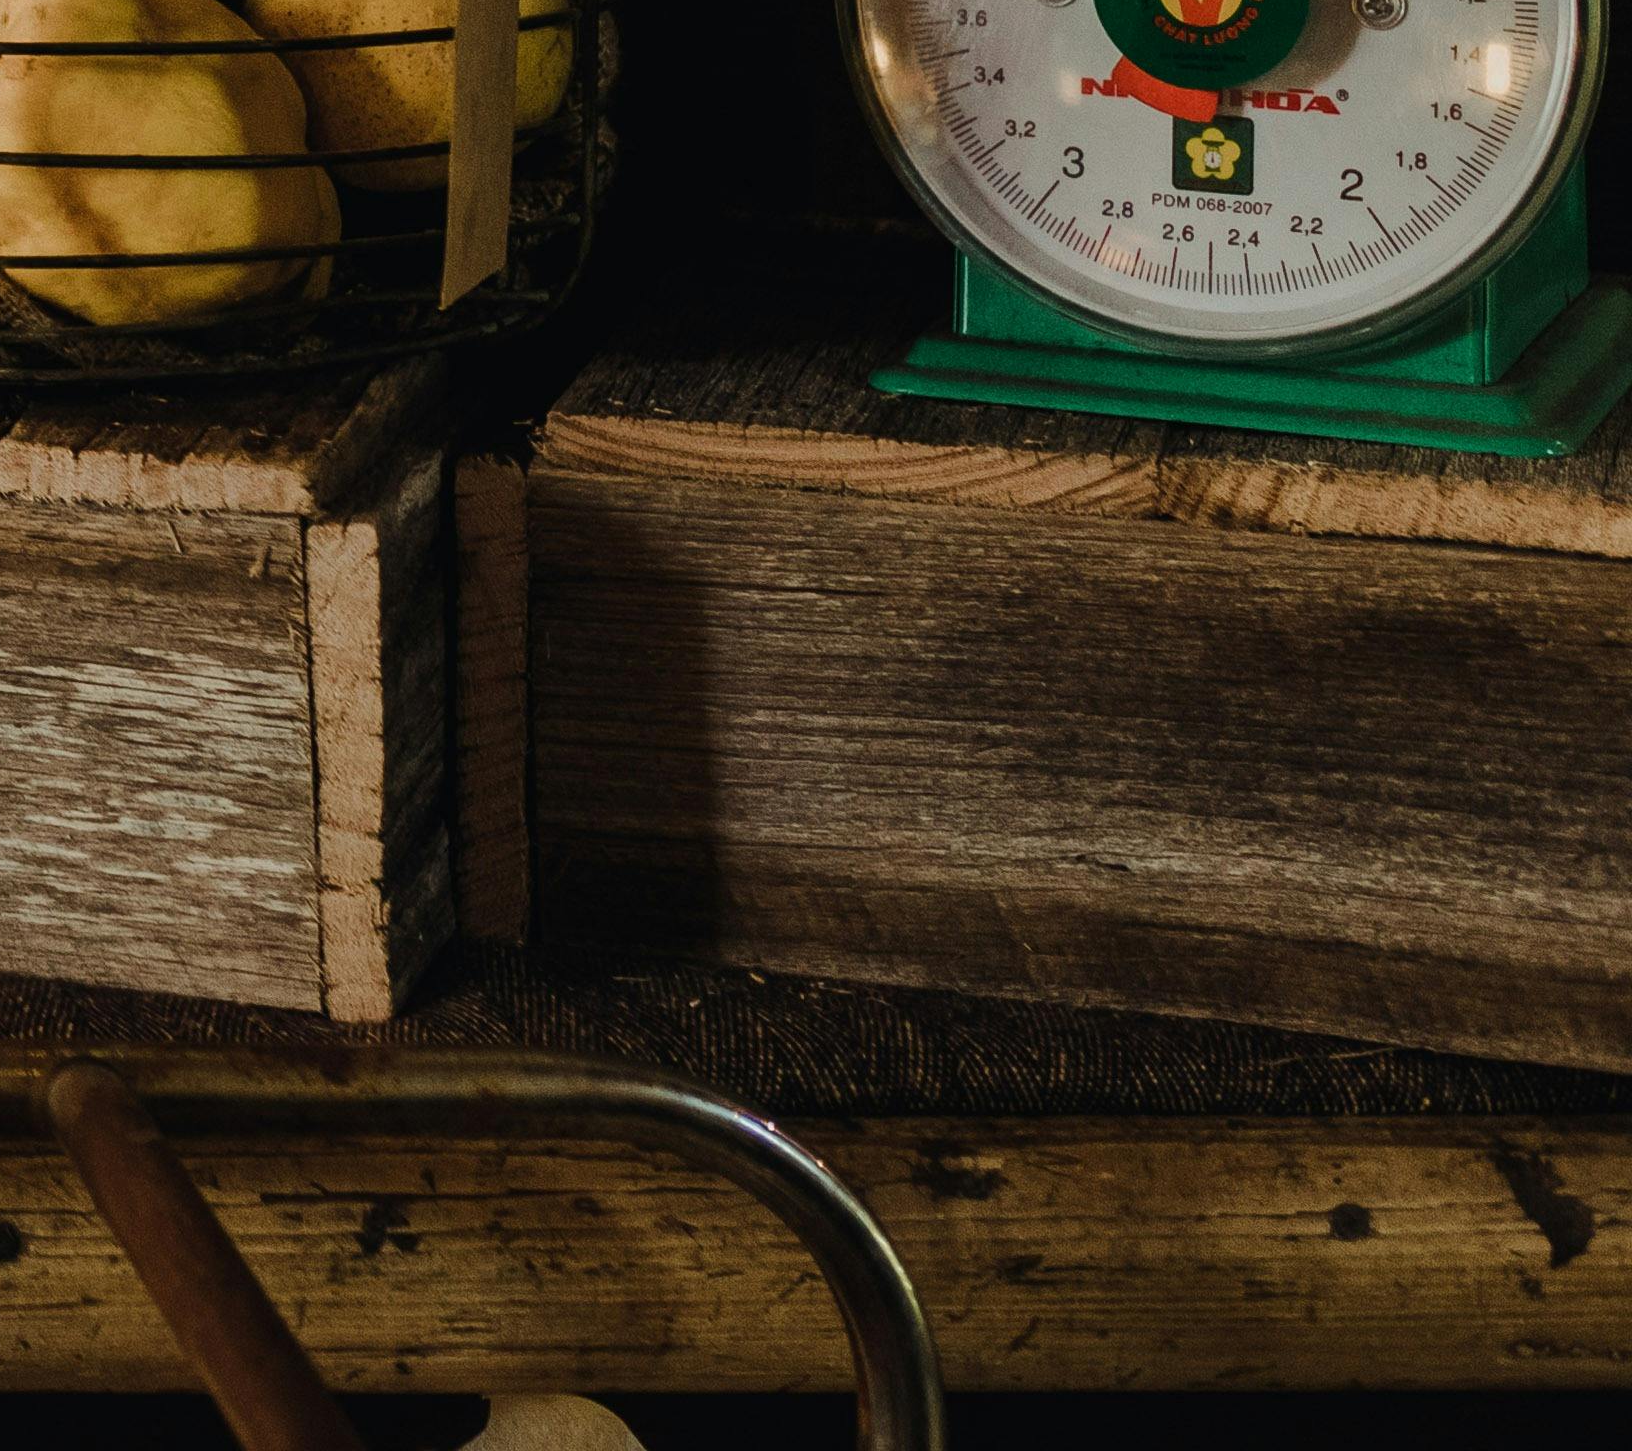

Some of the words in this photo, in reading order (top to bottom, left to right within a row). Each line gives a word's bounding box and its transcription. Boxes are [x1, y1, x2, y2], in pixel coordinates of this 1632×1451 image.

[1450, 45, 1480, 65] 1,4
[973, 66, 1005, 87] 3,4
[1431, 102, 1463, 122] 1,6
[1004, 119, 1036, 139] 3,2
[1061, 146, 1086, 179] 3
[1396, 150, 1428, 172] 1,8
[1339, 168, 1364, 202] 2
[1102, 200, 1134, 219] 2,8
[1151, 193, 1190, 209] PDM
[1196, 197, 1273, 217] 068-2007
[1162, 223, 1195, 243] 2,6
[1290, 215, 1324, 237] 2,2
[1227, 228, 1260, 249] 2,4
